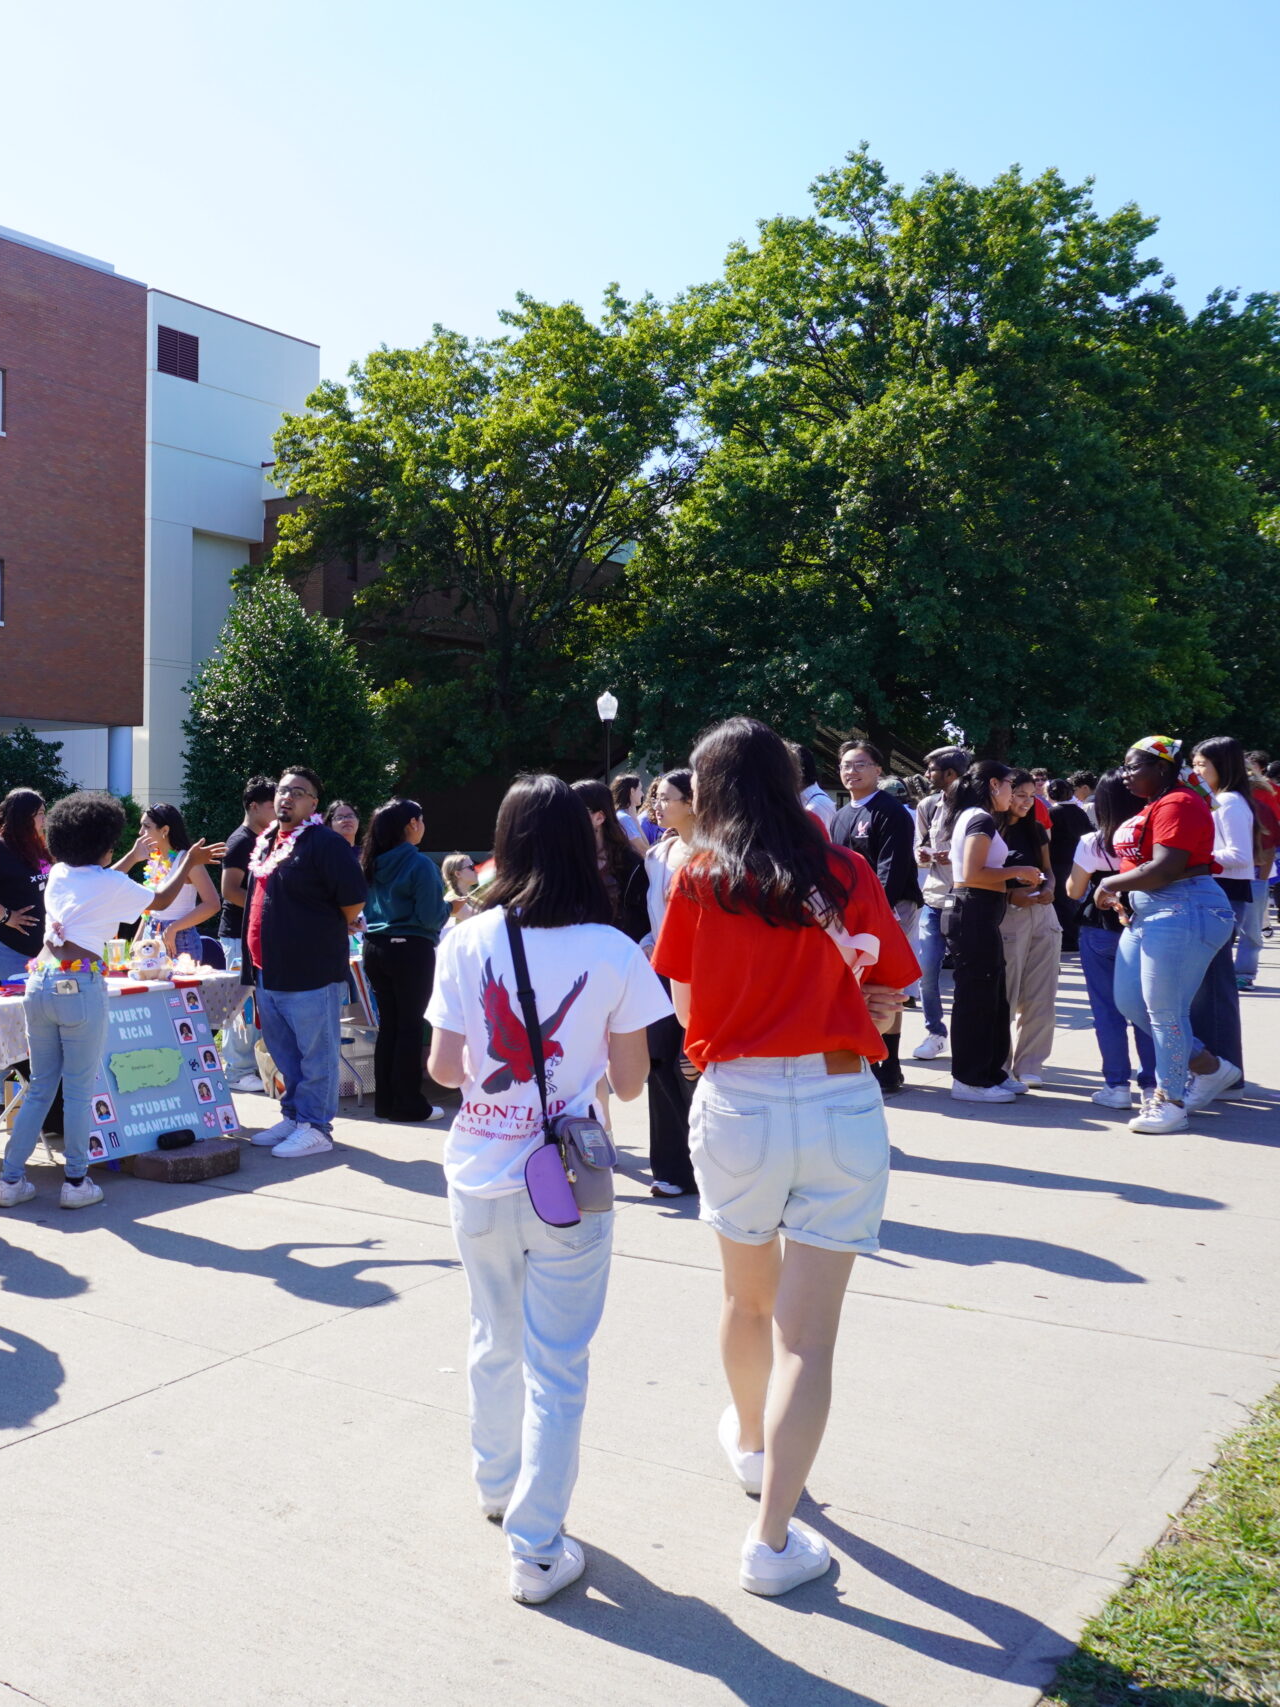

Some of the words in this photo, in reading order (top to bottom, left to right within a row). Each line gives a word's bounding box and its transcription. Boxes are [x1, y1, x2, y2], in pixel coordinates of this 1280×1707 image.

[109, 1006, 151, 1024] PUERTO
[119, 1024, 153, 1040] RICAN
[130, 1096, 181, 1117] STUDENT
[461, 1100, 566, 1122] MONTCLIR
[124, 1112, 199, 1137] ORGANIZATION
[460, 1114, 491, 1126] TATE
